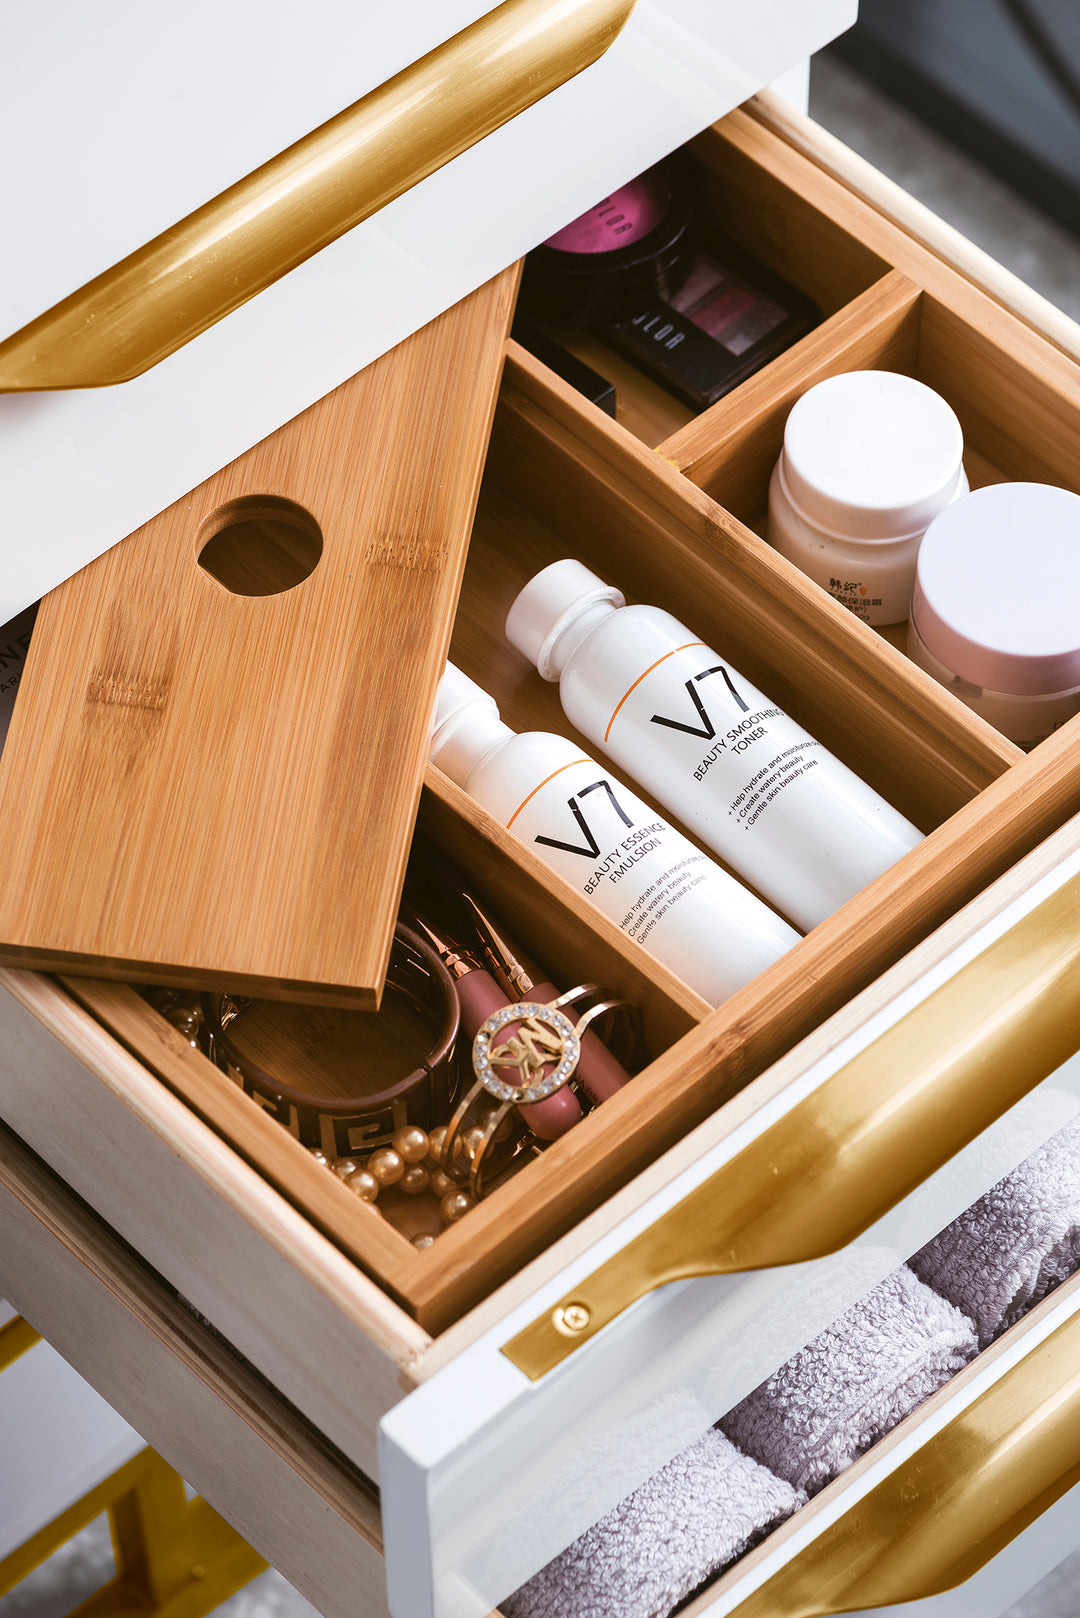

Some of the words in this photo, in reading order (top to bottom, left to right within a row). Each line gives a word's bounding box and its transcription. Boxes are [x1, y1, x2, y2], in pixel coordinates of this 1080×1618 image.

[650, 665, 750, 741] V7
[693, 739, 727, 782] BEAUTY
[726, 708, 784, 742] SMOOTHING
[731, 726, 768, 755] TONER
[730, 792, 746, 811] Help
[743, 767, 769, 794] hydrate
[768, 756, 782, 769] and
[739, 792, 760, 818] Create
[758, 770, 782, 794] watery
[780, 755, 804, 773] beauty
[747, 800, 768, 826] Gentle
[766, 786, 781, 802] skin
[779, 767, 804, 788] beauty
[803, 760, 818, 771] care
[534, 780, 634, 860] V7
[583, 848, 621, 895] BEAUTY
[620, 822, 666, 851] ESSENCE
[619, 910, 634, 930] Help
[631, 884, 657, 913] hydrate
[655, 872, 670, 887] and
[628, 911, 649, 937] Create
[646, 887, 670, 912] watery
[667, 871, 692, 890] beauty
[637, 919, 657, 944] Gentle
[655, 904, 670, 920] skin
[667, 884, 692, 906] beauty
